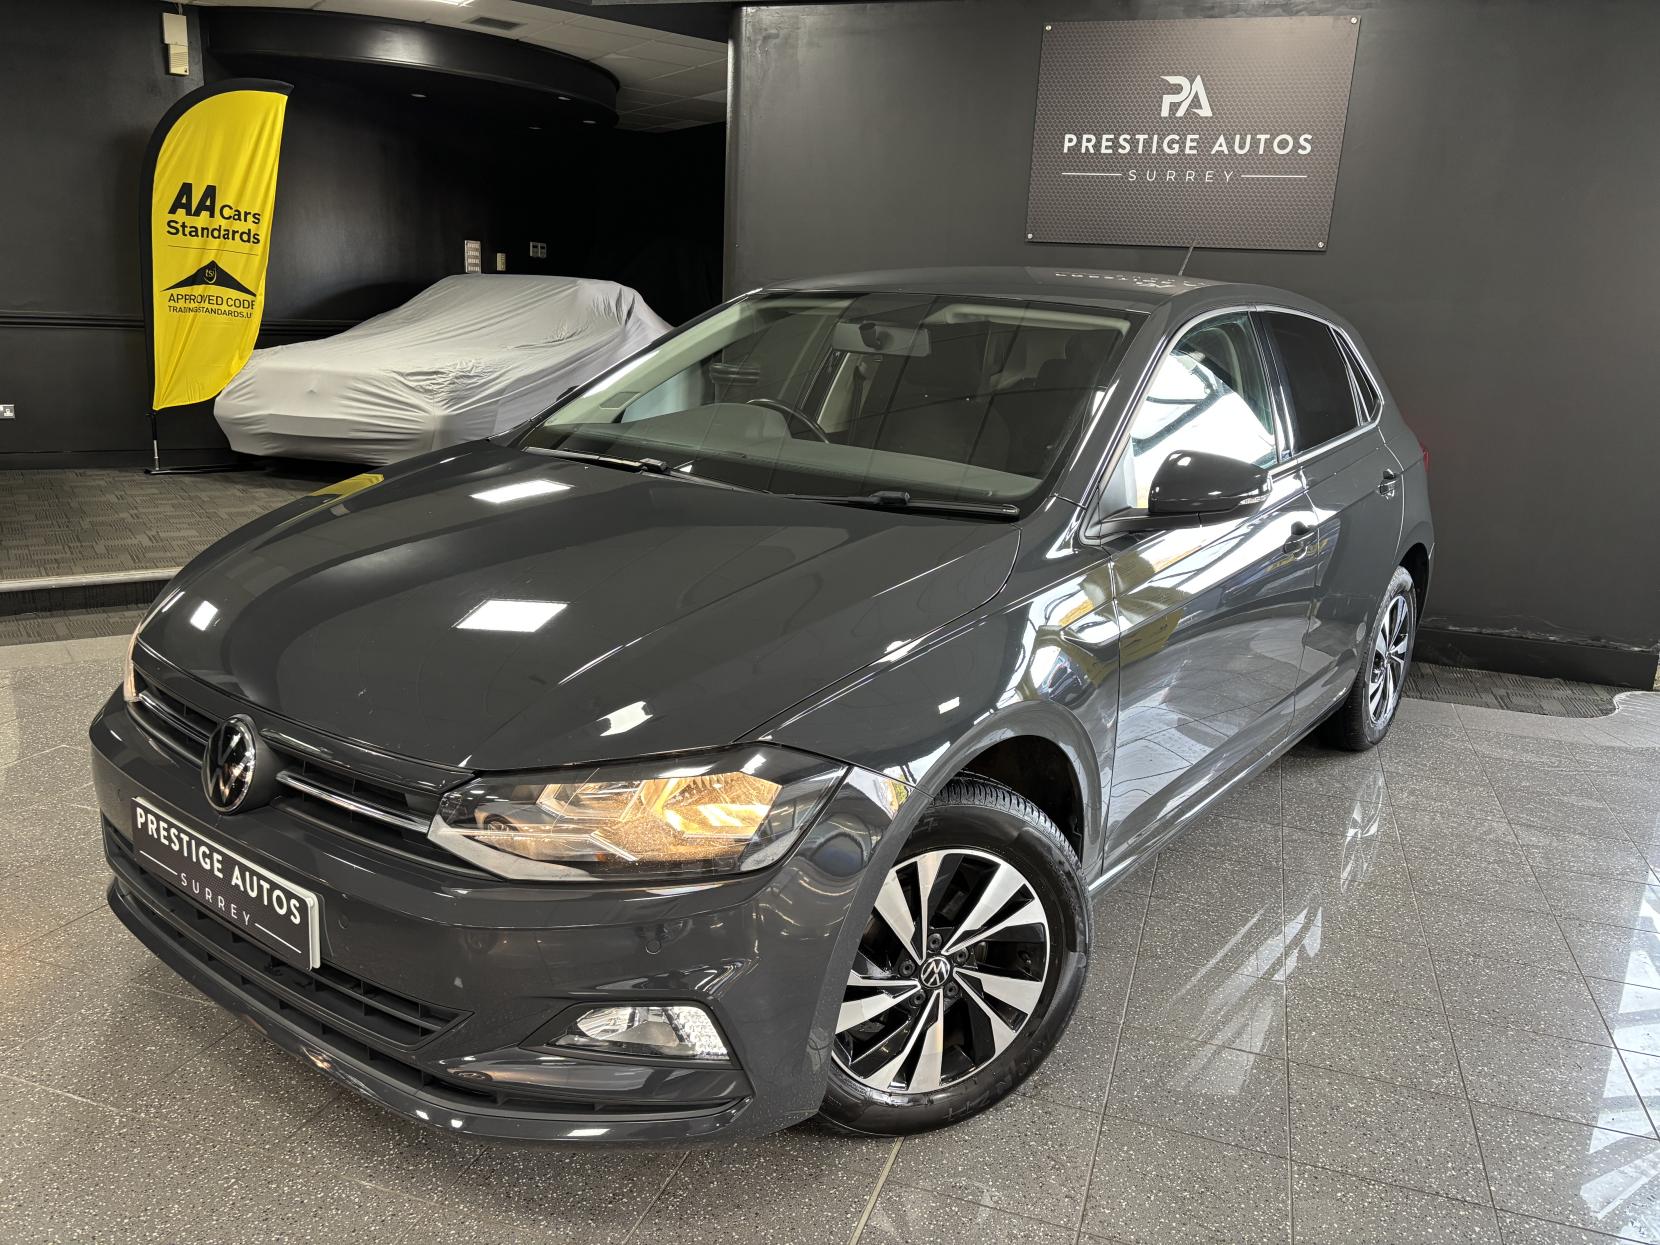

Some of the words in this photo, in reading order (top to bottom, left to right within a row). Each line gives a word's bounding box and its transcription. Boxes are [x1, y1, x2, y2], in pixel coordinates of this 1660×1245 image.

[1160, 74, 1213, 117] PA
[1063, 133, 1200, 155] PRESTIGE
[1211, 133, 1313, 155] AUTOS
[1128, 169, 1234, 182] SURREY
[167, 181, 217, 219] AA
[219, 204, 261, 225] Cars
[166, 219, 261, 245] Standards
[168, 293, 224, 306] APPROVED
[136, 807, 224, 879] PRESTIGE
[231, 865, 301, 925] AUTOS
[180, 872, 250, 926] SURREY
